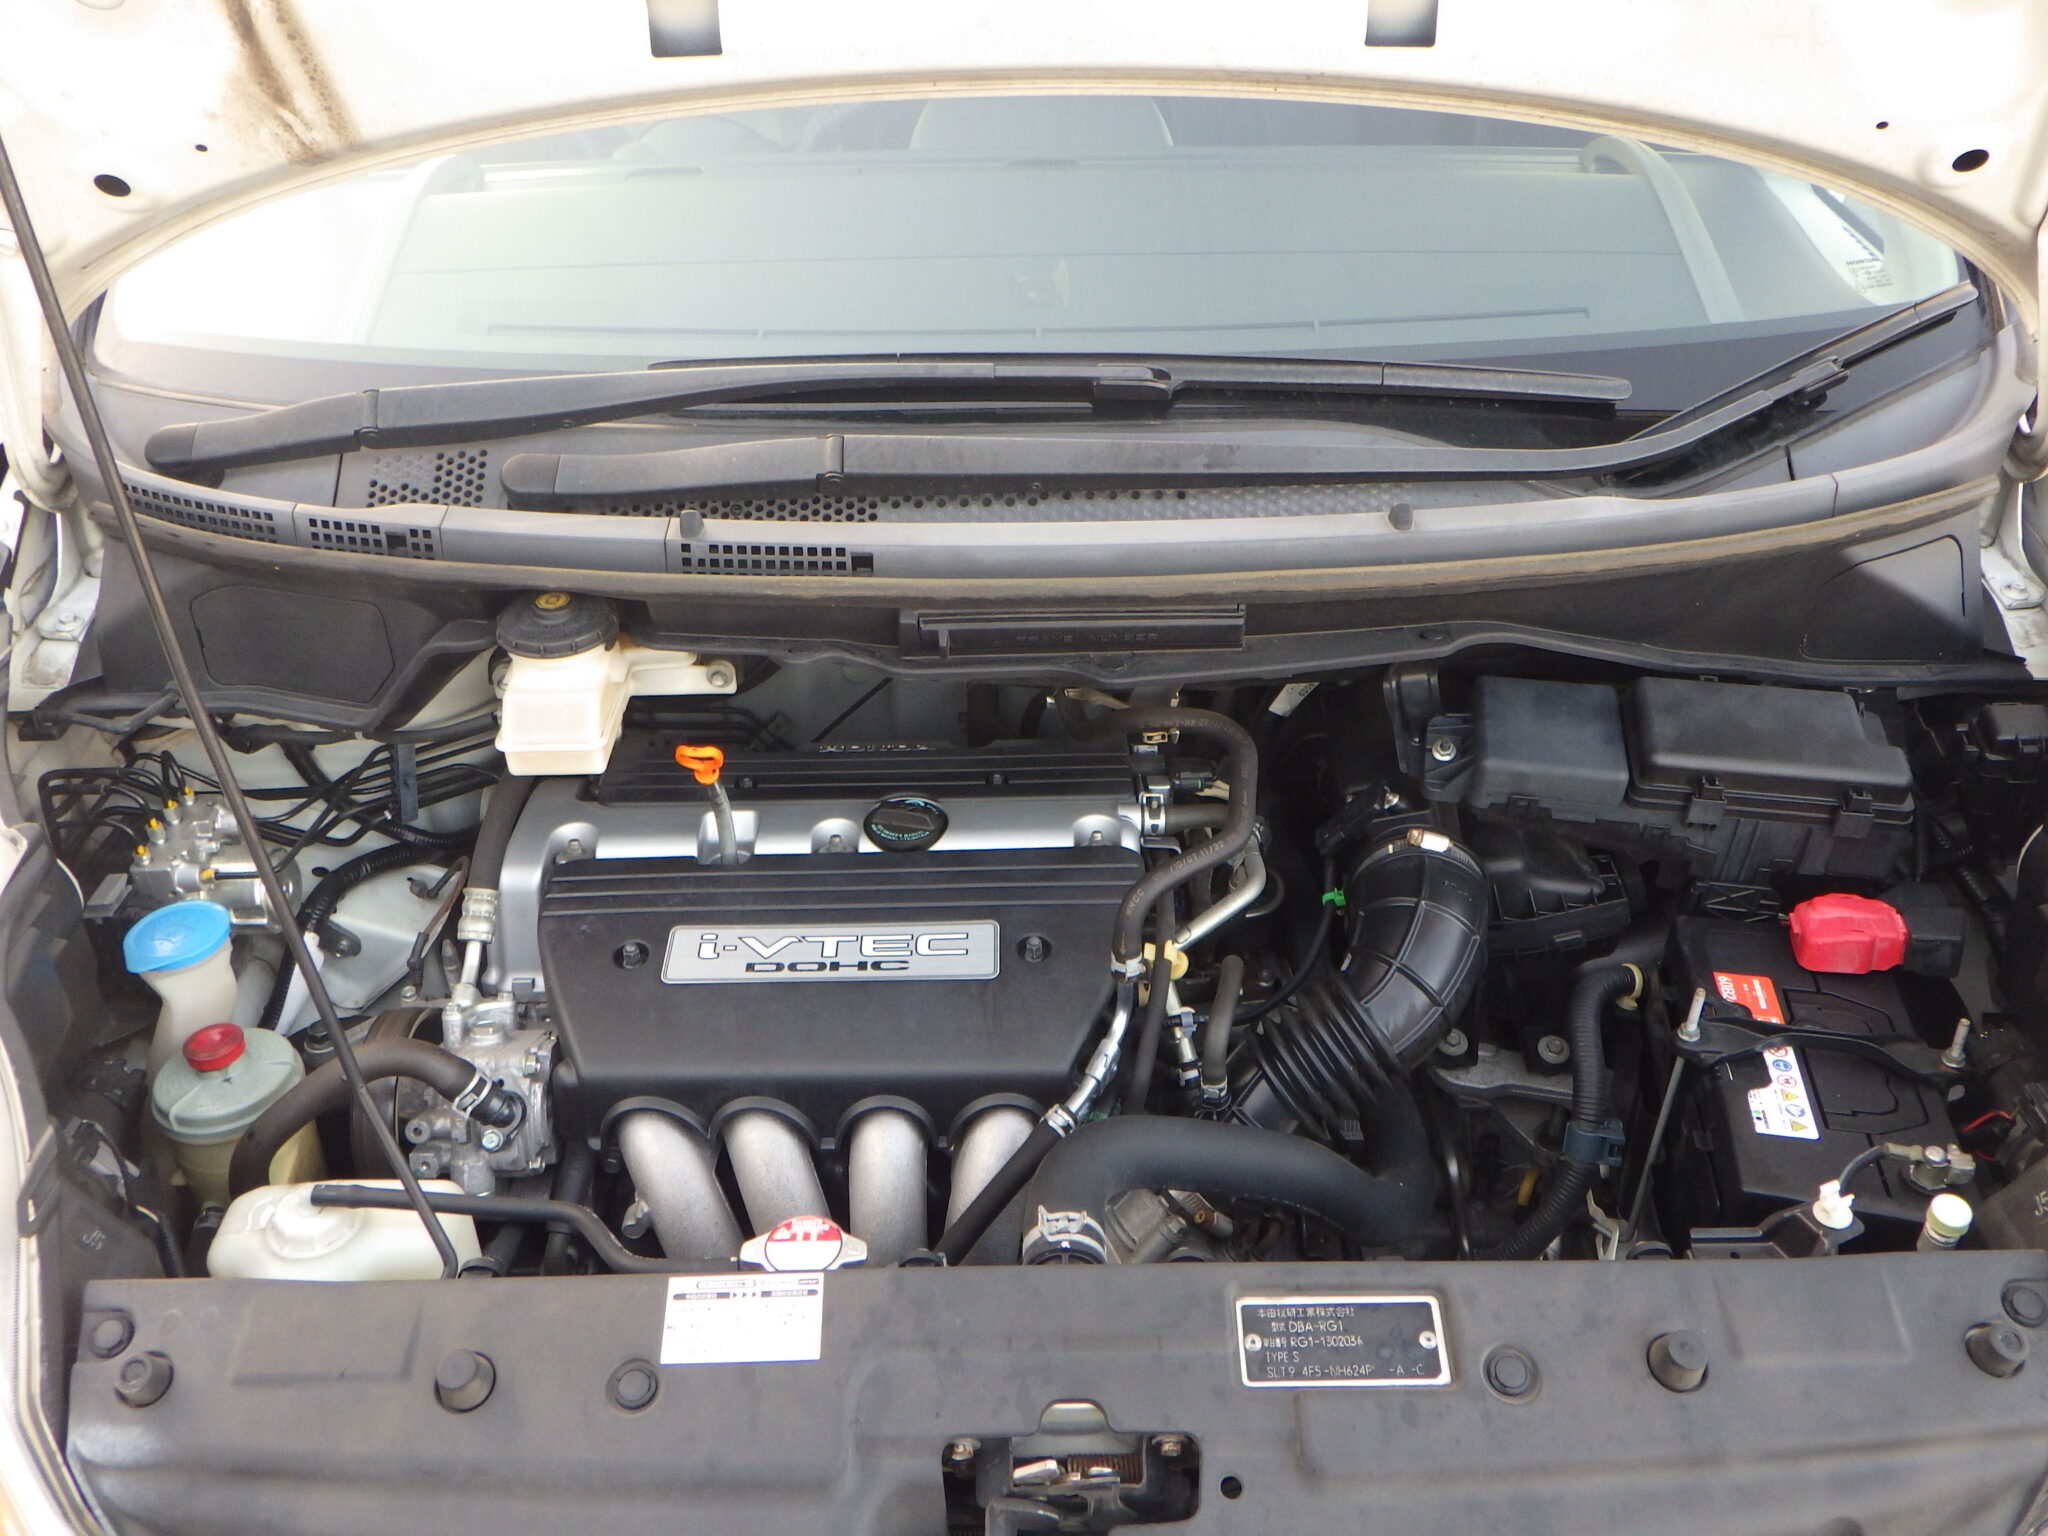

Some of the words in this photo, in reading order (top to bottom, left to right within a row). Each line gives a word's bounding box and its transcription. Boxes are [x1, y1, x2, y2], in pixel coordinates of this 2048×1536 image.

[698, 932, 969, 960] i-VTEC
[745, 960, 910, 973] DOHC
[1717, 975, 1738, 1003] 60B2
[1289, 1320, 1343, 1333] DBA-RG1
[1265, 1351, 1289, 1363] TYPE
[1292, 1350, 1300, 1363] S
